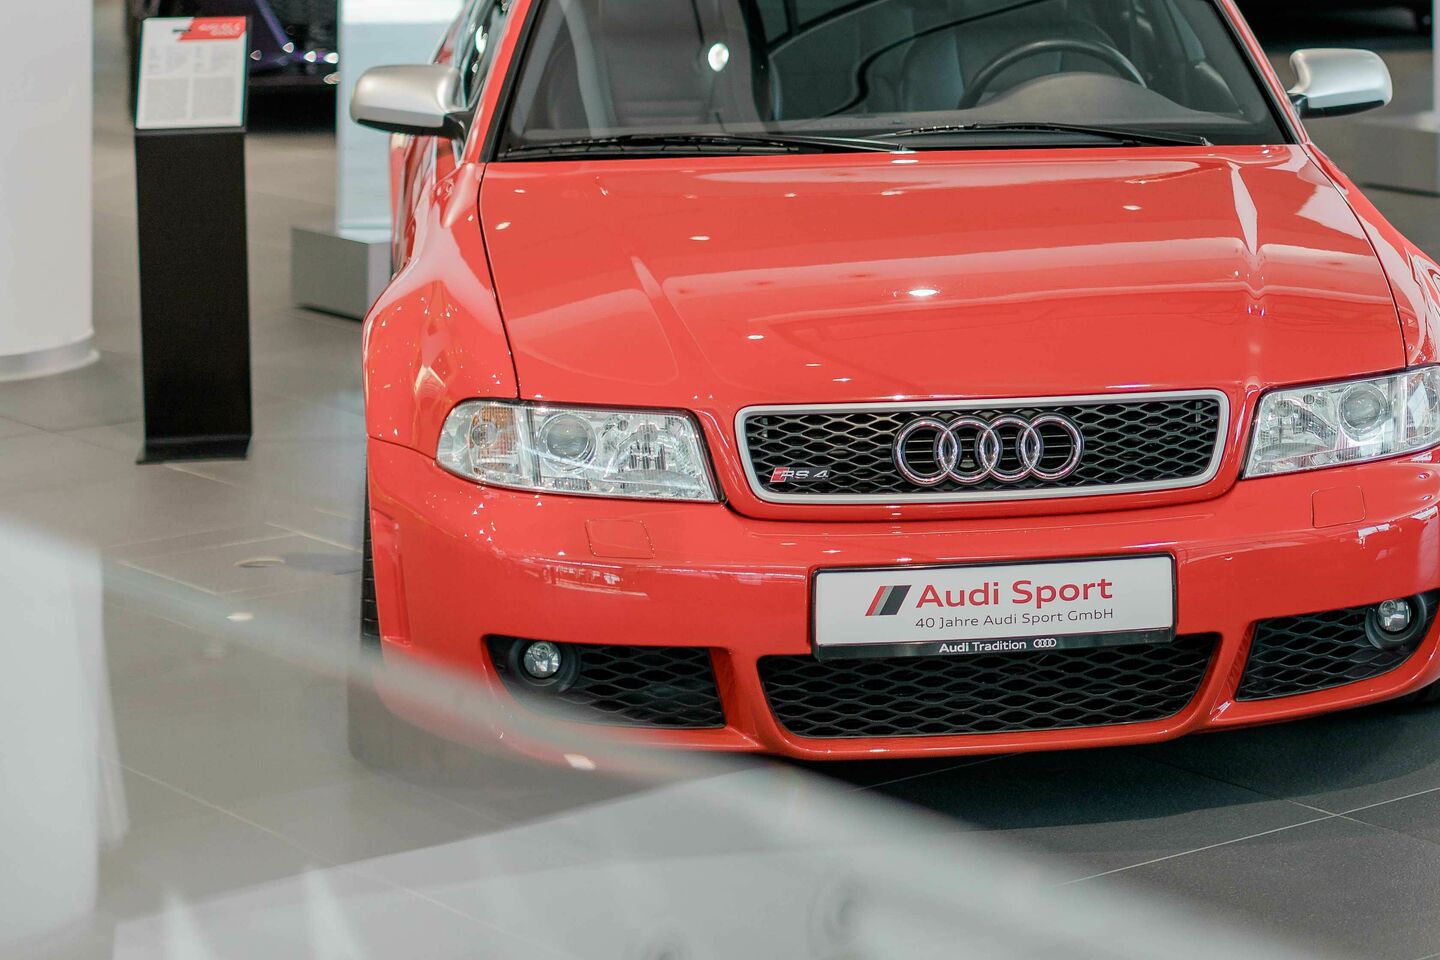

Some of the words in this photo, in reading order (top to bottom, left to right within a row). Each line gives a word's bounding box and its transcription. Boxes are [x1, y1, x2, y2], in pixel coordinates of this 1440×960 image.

[916, 581, 1000, 609] Audi
[1012, 578, 1114, 609] Sport
[915, 617, 935, 629] 40
[939, 616, 979, 630] Jahre
[983, 613, 1017, 626] Audi
[1022, 611, 1064, 626] Sport
[1067, 608, 1113, 622] GmbH
[938, 642, 969, 654] Audi
[972, 639, 1027, 652] Tradition
